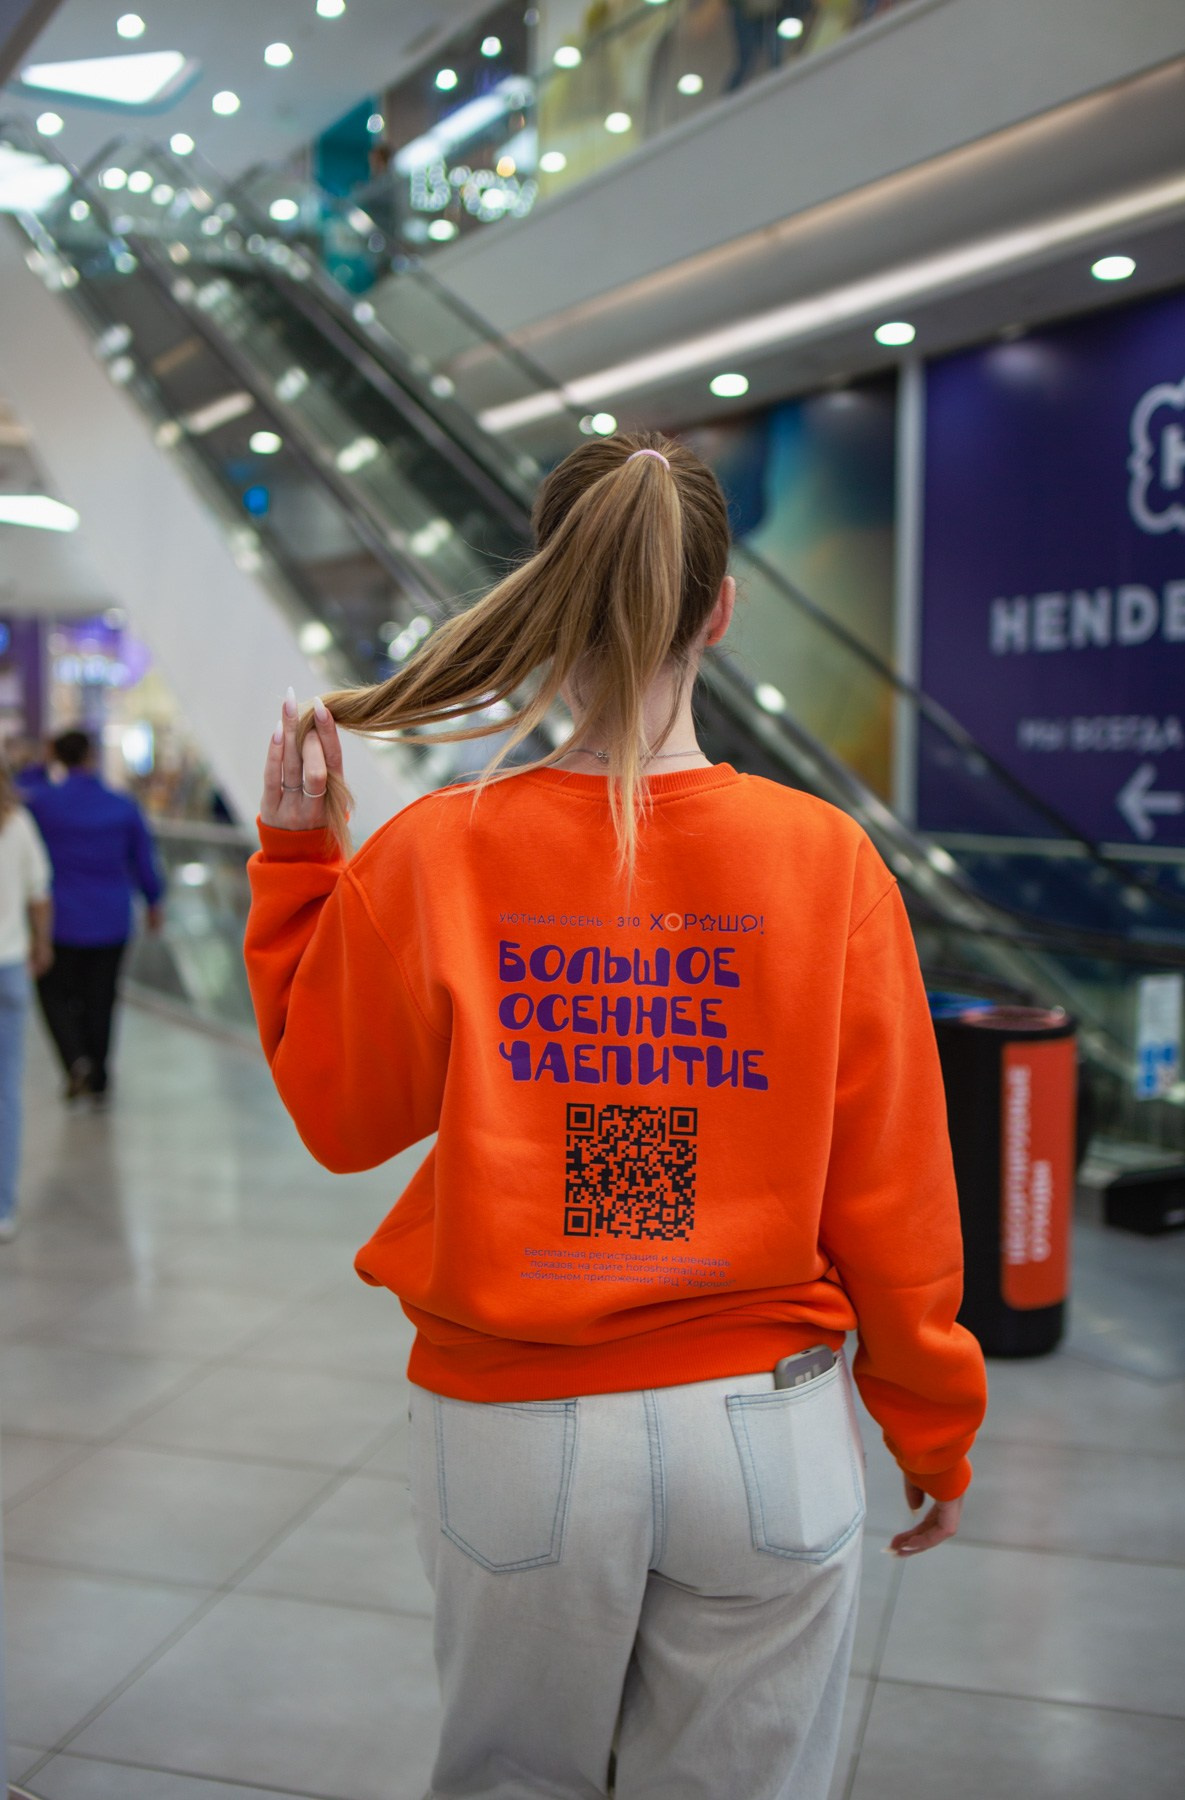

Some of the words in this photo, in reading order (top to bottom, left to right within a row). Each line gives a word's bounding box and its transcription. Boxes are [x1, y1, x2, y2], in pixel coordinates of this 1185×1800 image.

[499, 912, 555, 925] УЮТНАЯ
[559, 915, 603, 927] ОСЕНЬ
[617, 916, 641, 928] ЭТО
[499, 940, 740, 988] БОЛЬШОЕ
[499, 992, 728, 1039] ОСЕННЕЕ
[499, 1040, 769, 1091] ЧАЕПИТИЕ
[524, 1247, 586, 1259] Бесплатная
[589, 1251, 658, 1263] регистрация
[671, 1255, 731, 1268] календарь
[578, 1262, 591, 1271] на
[593, 1262, 623, 1272] сайте
[520, 1269, 581, 1281] мобильном
[584, 1273, 654, 1285] приложении
